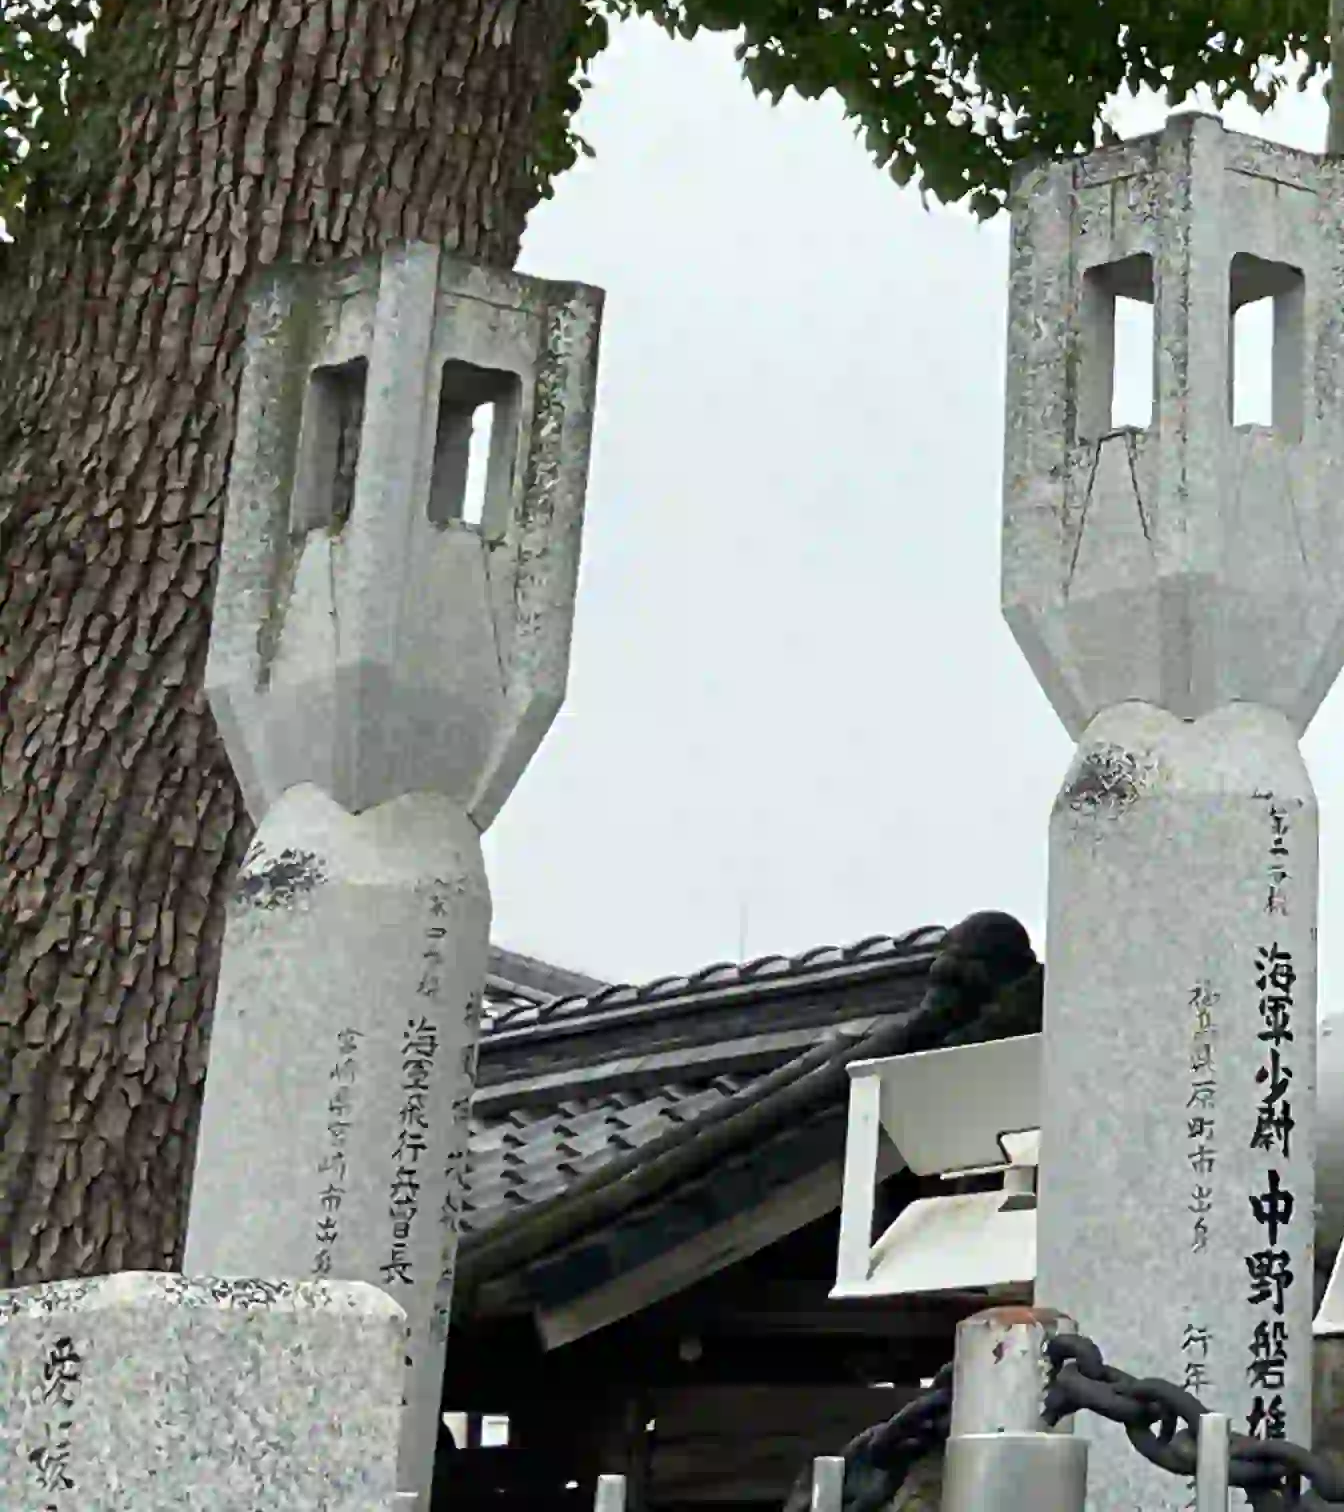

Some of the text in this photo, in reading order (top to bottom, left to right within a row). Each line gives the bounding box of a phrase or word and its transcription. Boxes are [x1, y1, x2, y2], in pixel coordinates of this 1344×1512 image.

[380, 1015, 438, 1286] 海軍飛行兵曹長
[1250, 941, 1297, 1158] 海軍少尉
